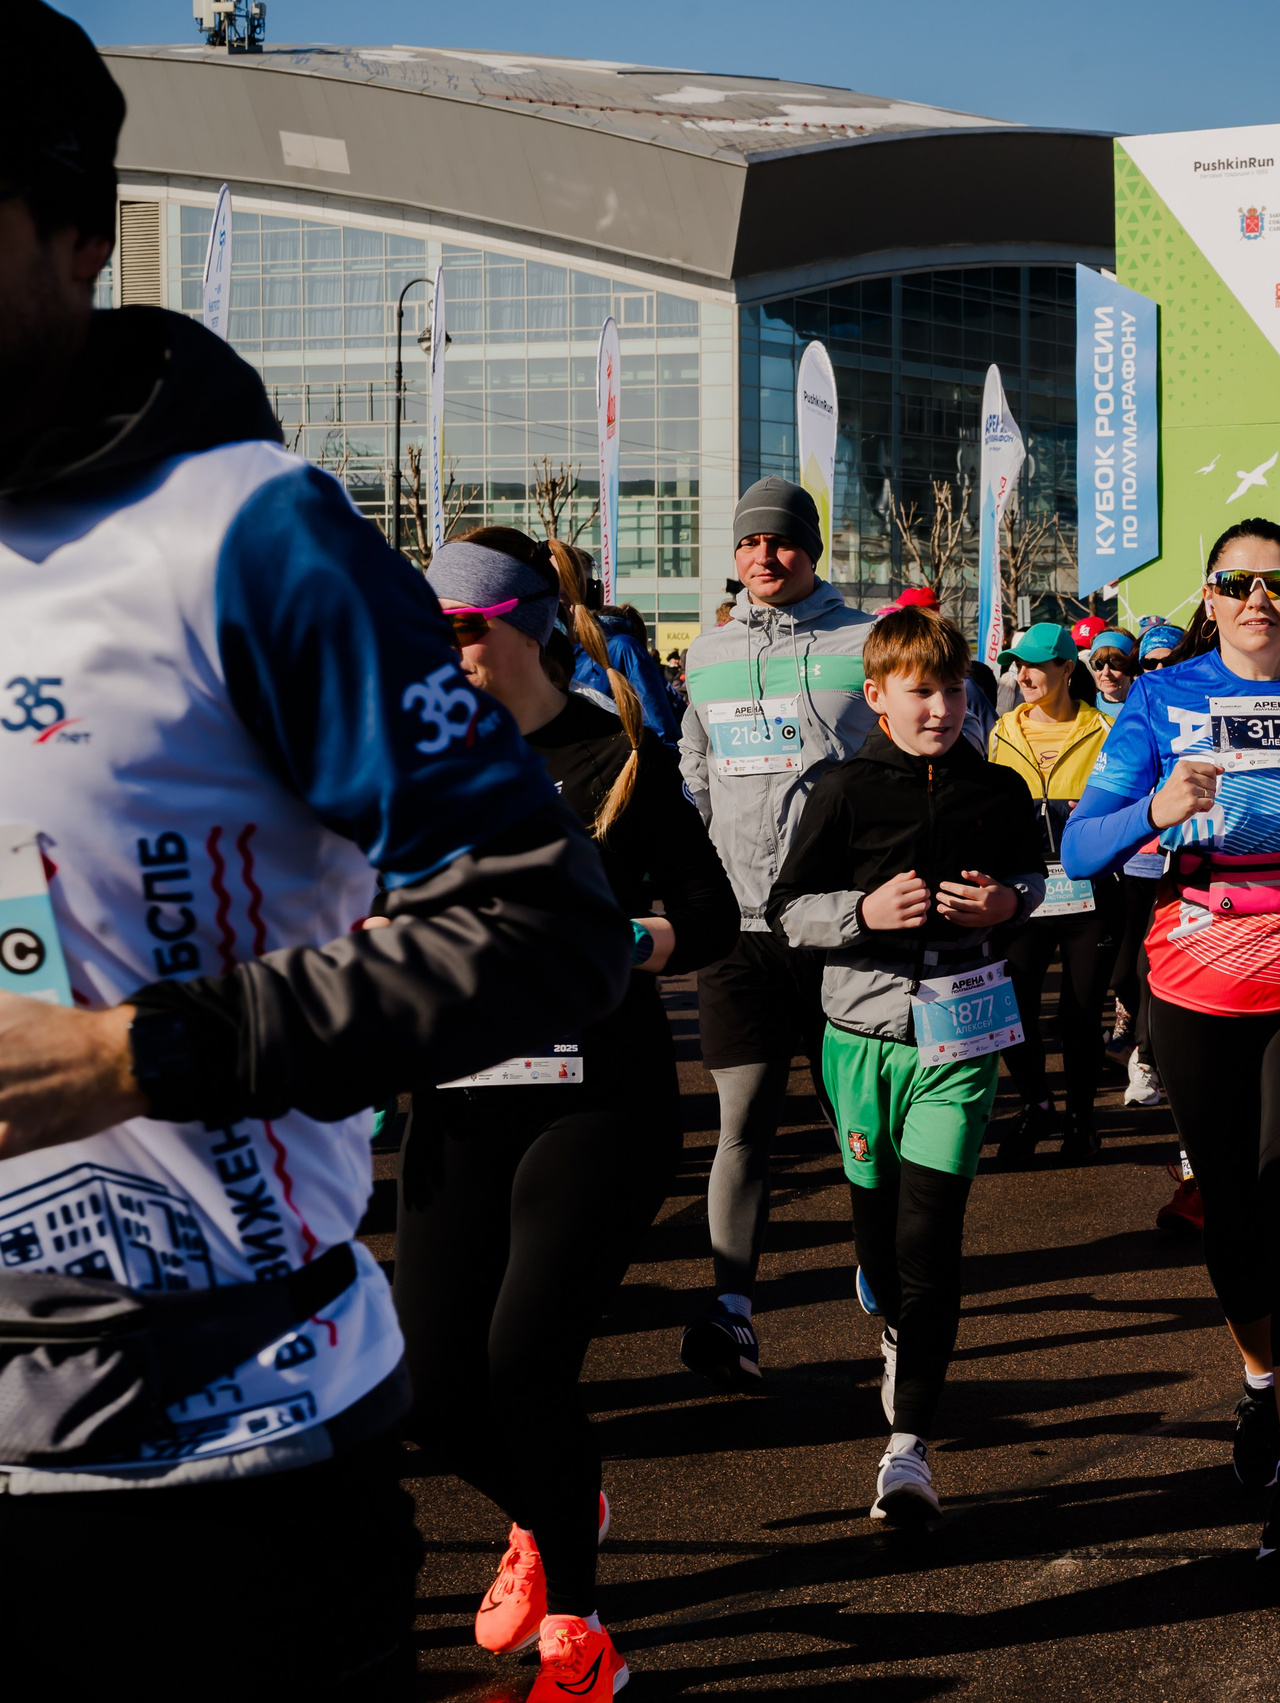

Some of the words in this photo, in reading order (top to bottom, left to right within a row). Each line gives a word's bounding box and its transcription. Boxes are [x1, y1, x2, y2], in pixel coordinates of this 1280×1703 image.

[1194, 157, 1275, 172] PushkinRun
[1094, 306, 1114, 437] РОССИИ
[1121, 311, 1137, 511] ПОЛУМАРАФОНУ
[1095, 443, 1115, 555] КУБОК
[1122, 515, 1138, 549] ПО
[666, 632, 690, 640] КАССА
[0, 676, 65, 732] 35
[402, 663, 478, 754] 35
[731, 724, 774, 746] 2163
[138, 831, 201, 976] БСПБ
[951, 975, 985, 990] АРЕНА
[948, 994, 994, 1027] 1877
[955, 1017, 993, 1036] АЛЕКСЕЙ
[554, 1044, 578, 1052] 2025
